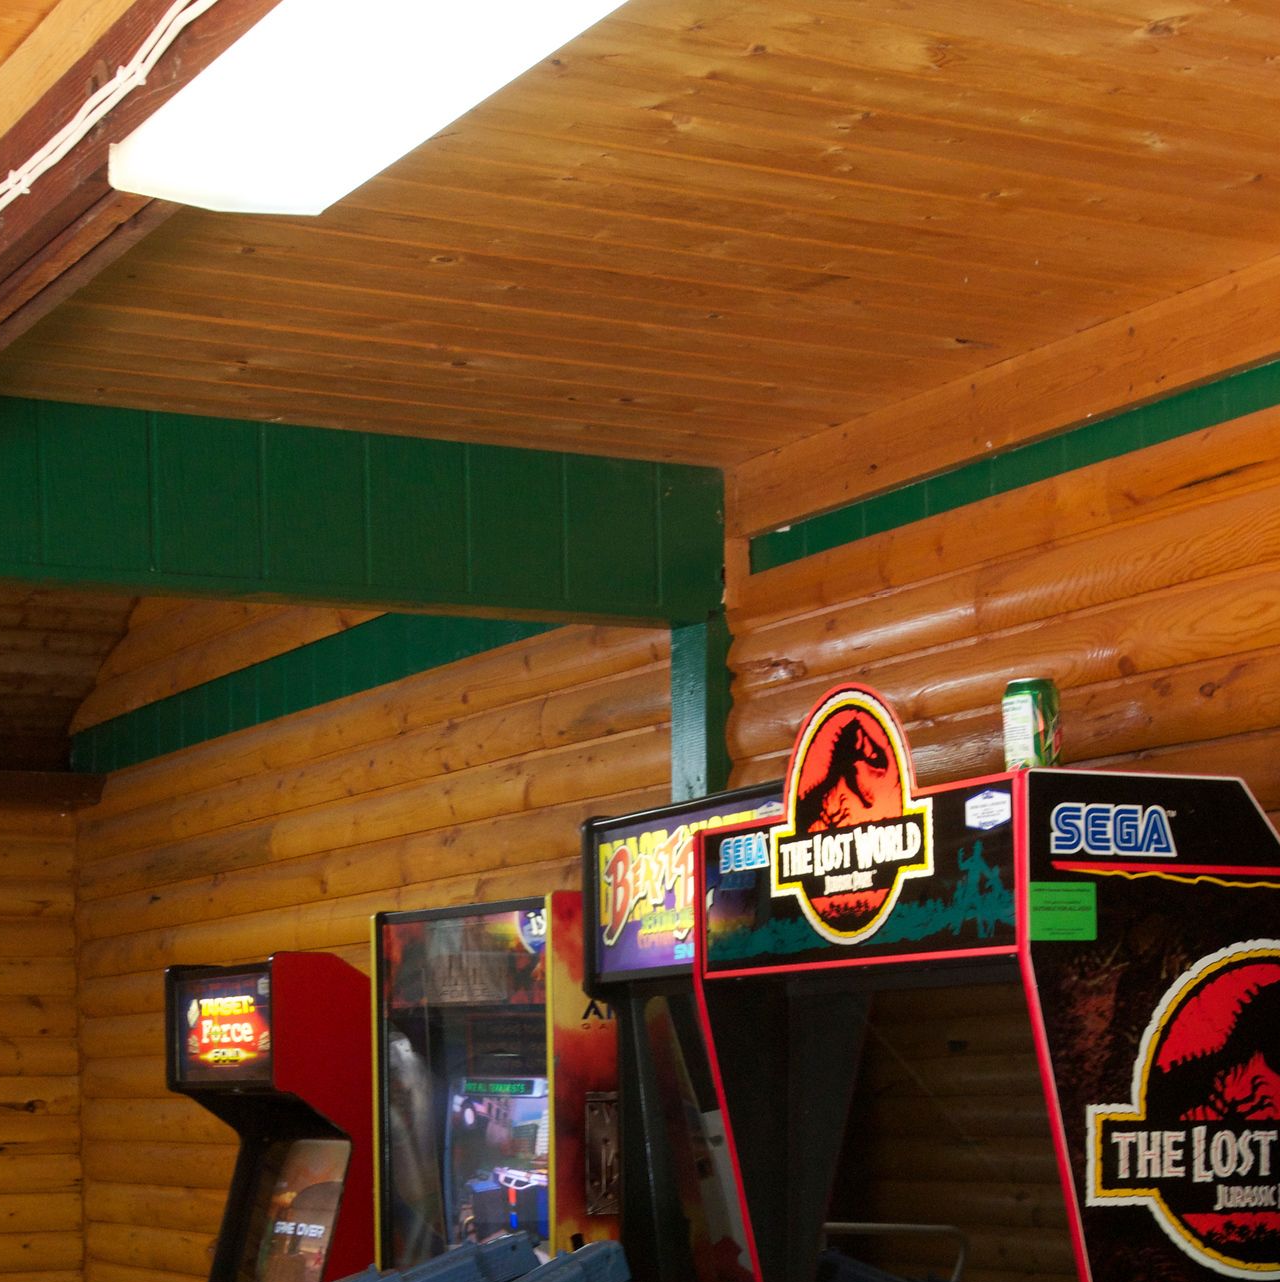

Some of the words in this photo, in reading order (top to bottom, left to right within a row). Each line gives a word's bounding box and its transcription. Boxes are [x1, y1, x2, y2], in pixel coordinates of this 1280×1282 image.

[720, 832, 770, 874] SEGA
[780, 838, 813, 877] THE
[813, 830, 854, 876] LOST
[853, 821, 922, 869] WORLD
[1051, 802, 1177, 857] SEGA
[201, 1020, 254, 1044] Force
[1111, 1131, 1186, 1179] THE
[1192, 1125, 1278, 1182] LOST
[1213, 1184, 1277, 1210] JURASSIC
